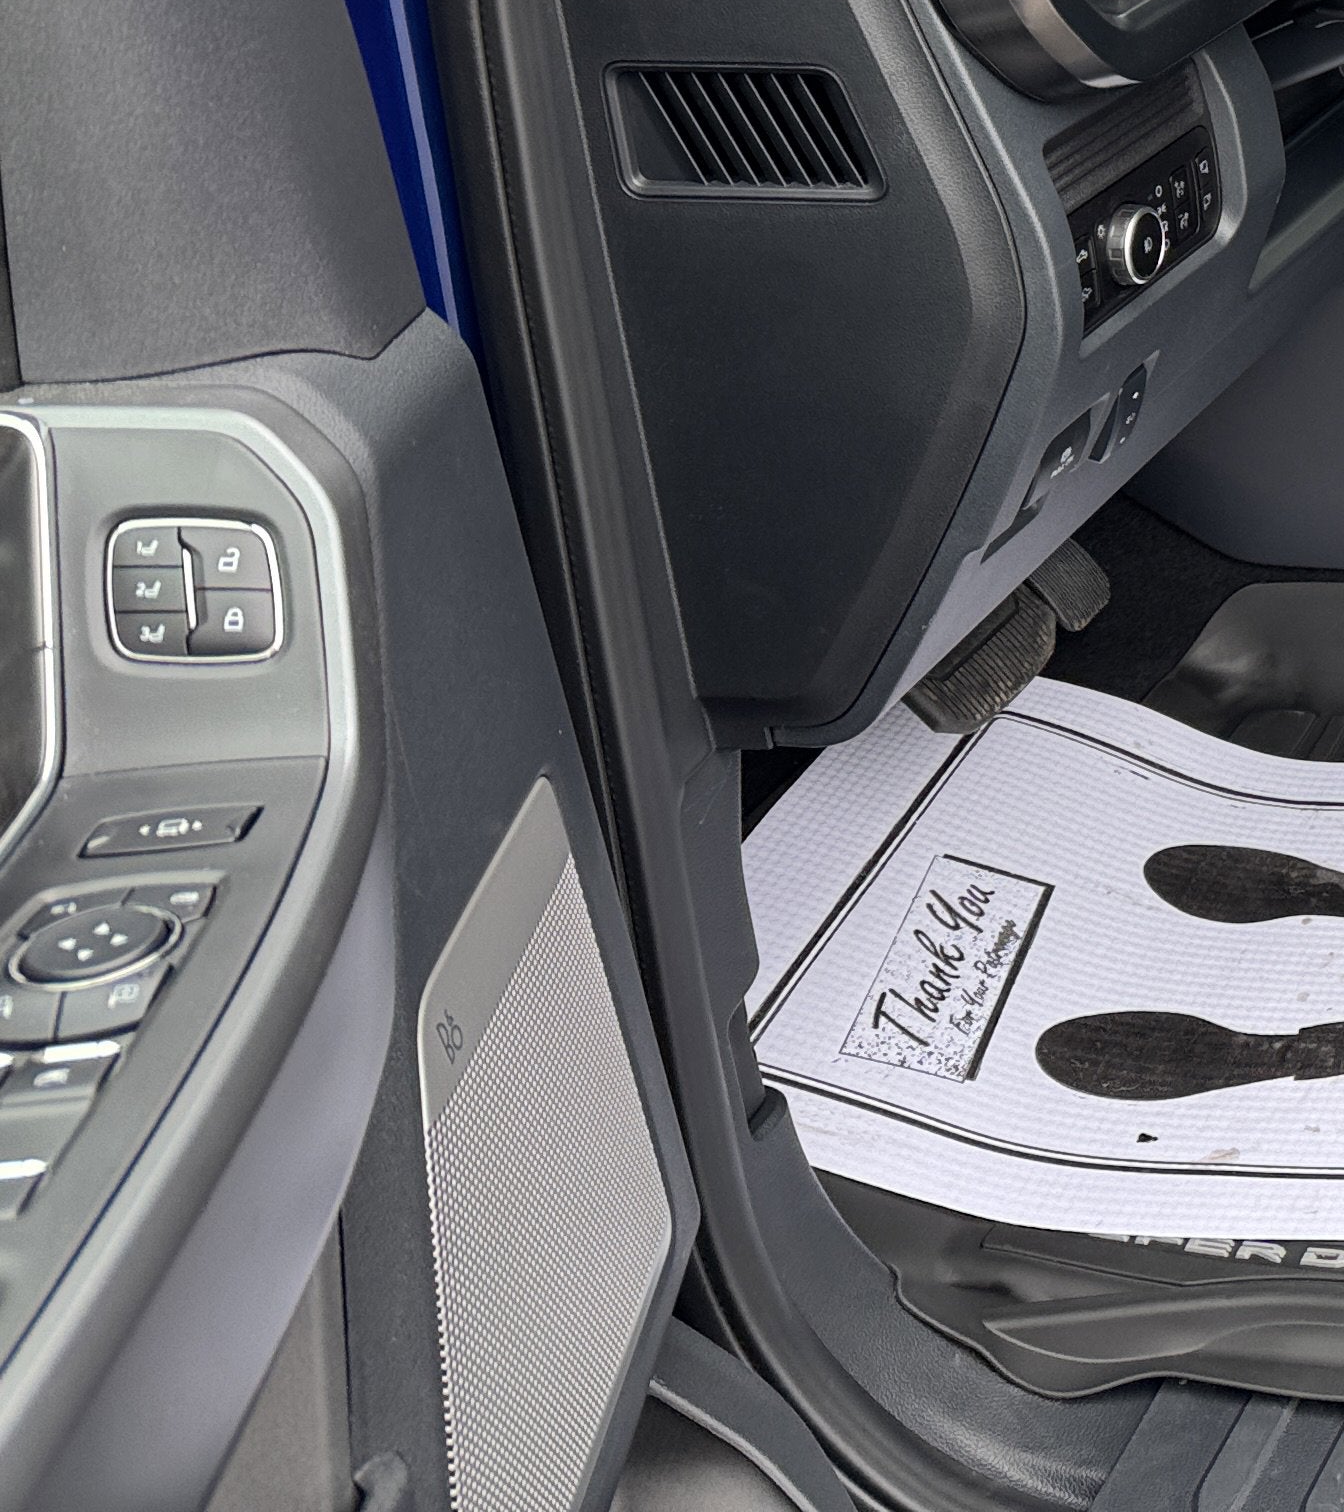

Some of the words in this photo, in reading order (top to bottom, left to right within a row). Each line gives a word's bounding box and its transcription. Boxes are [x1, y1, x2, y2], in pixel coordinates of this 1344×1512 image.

[871, 928, 966, 1047] Thank
[926, 883, 996, 934] You
[960, 979, 990, 1008] Your
